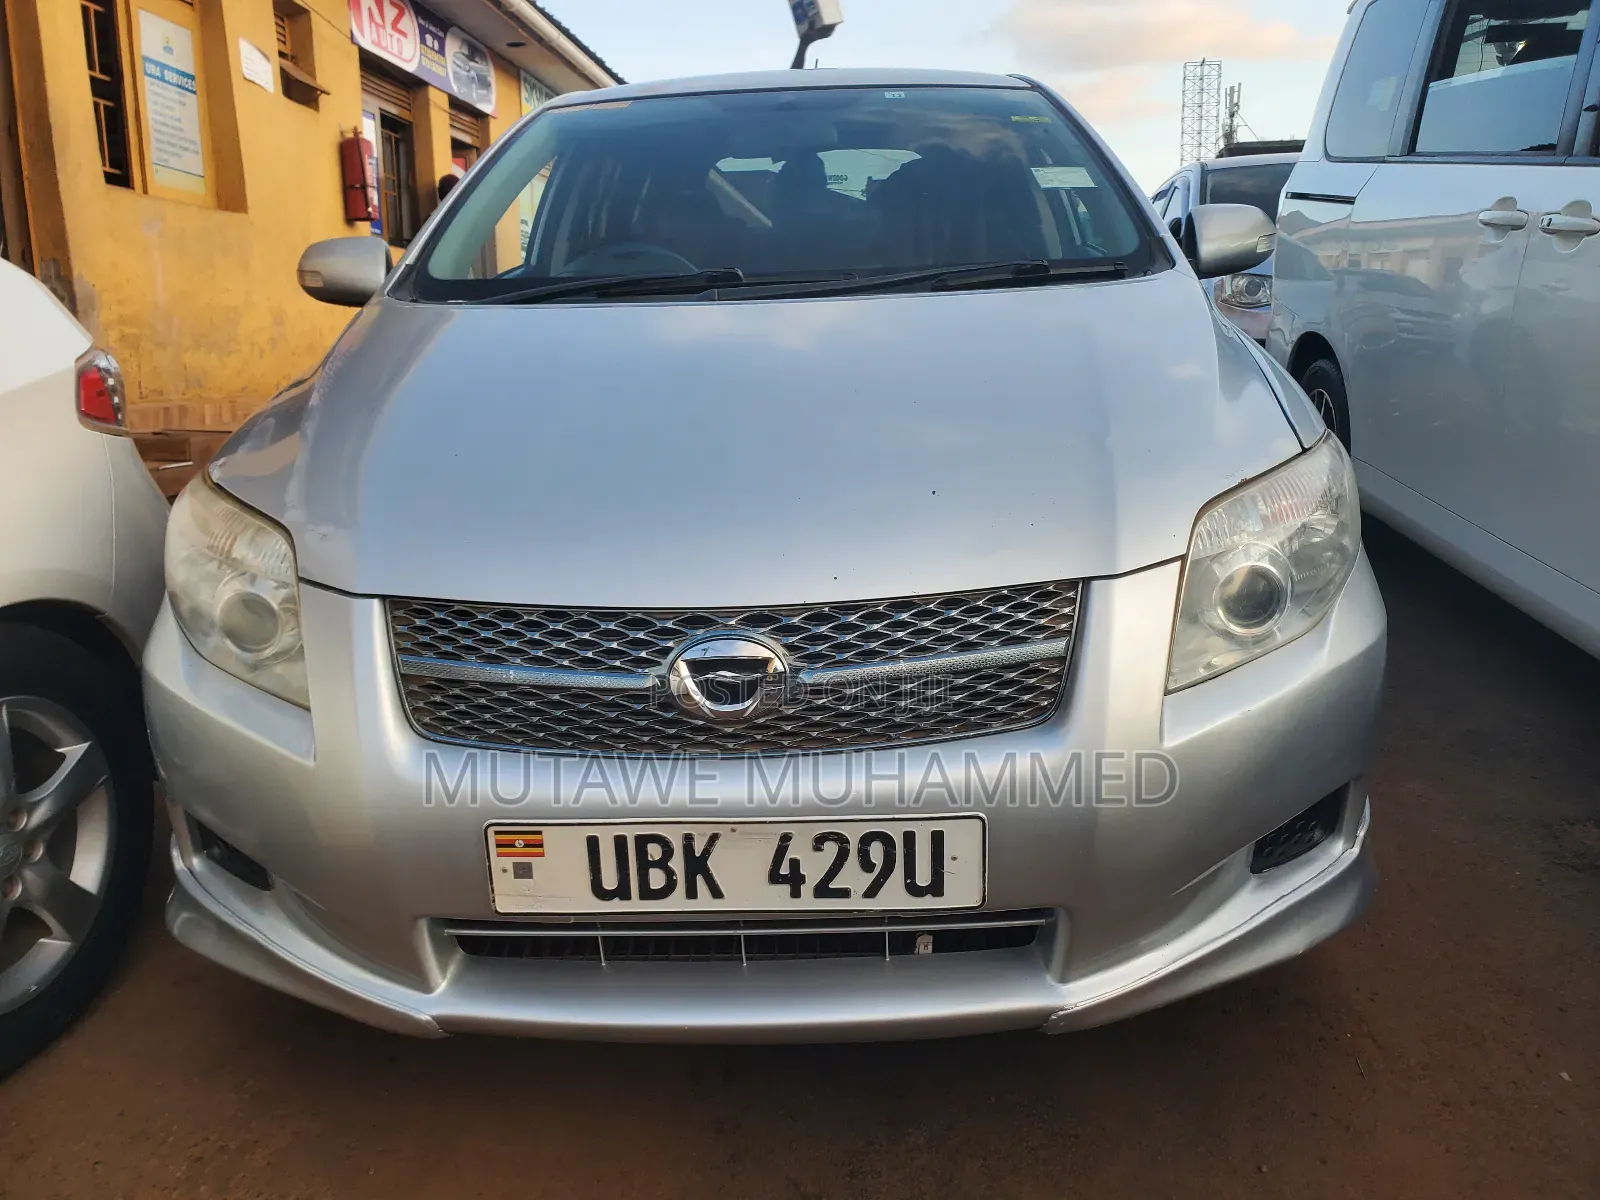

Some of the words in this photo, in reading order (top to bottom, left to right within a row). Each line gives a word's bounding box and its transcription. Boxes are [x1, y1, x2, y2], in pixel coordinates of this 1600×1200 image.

[145, 61, 161, 78] URA
[164, 69, 196, 91] SERVICES
[586, 832, 725, 902] UBK
[768, 829, 945, 899] 429U
